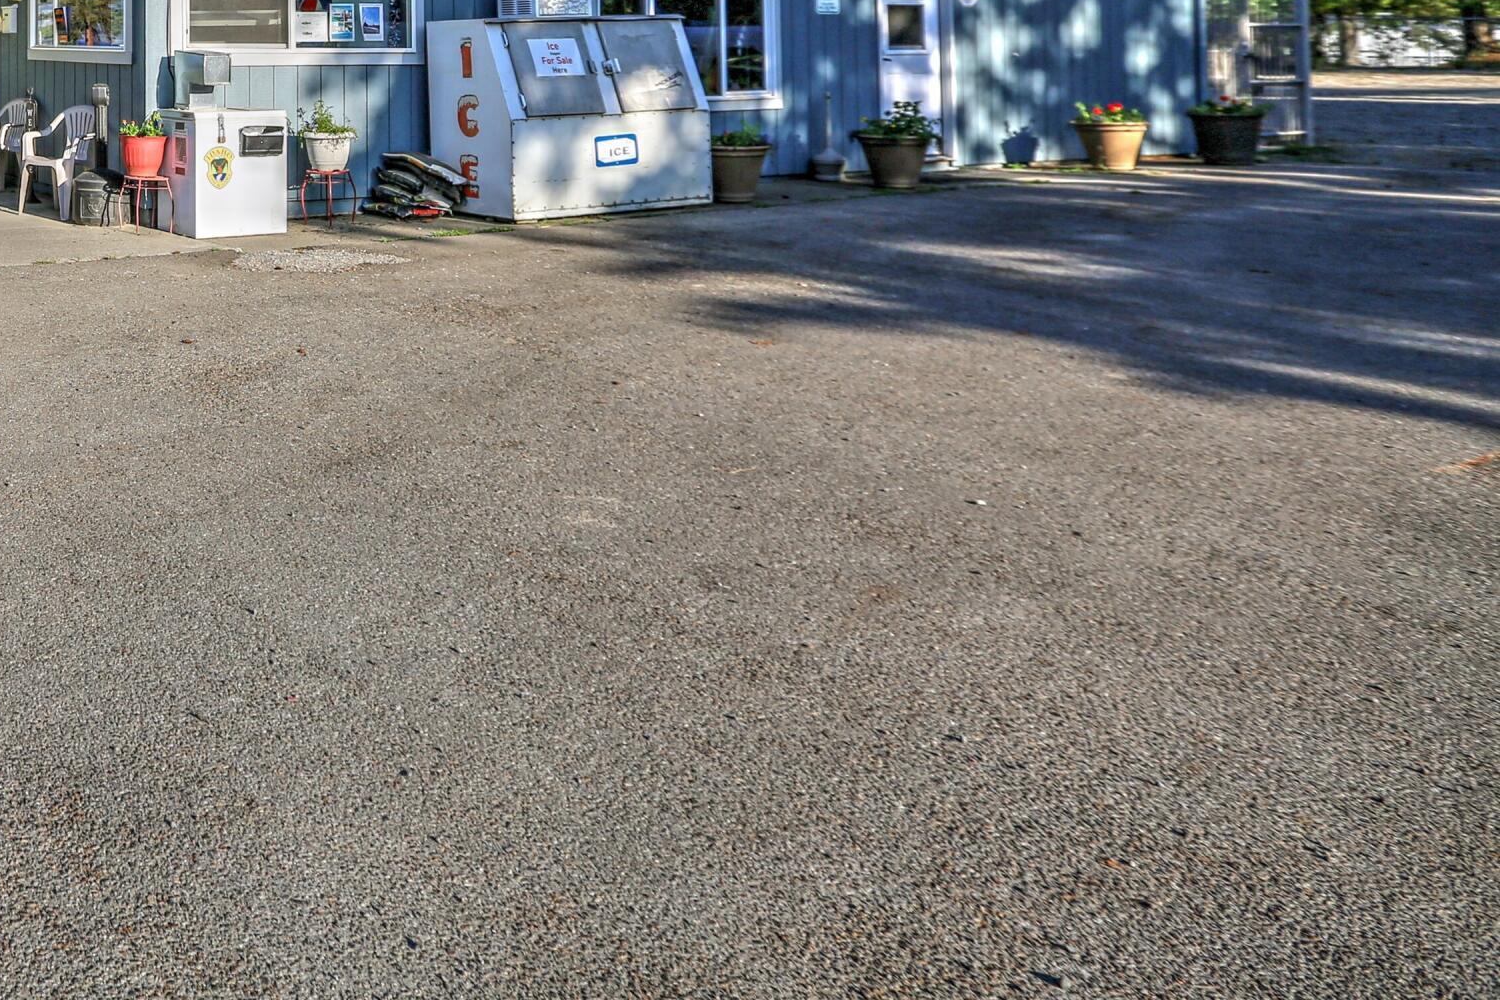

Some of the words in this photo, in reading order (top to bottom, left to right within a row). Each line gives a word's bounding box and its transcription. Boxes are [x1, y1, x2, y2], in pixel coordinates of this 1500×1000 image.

[546, 42, 559, 50] Ice
[541, 56, 555, 64] For
[556, 56, 573, 65] Sale
[552, 66, 568, 74] Here
[609, 146, 631, 157] ICE
